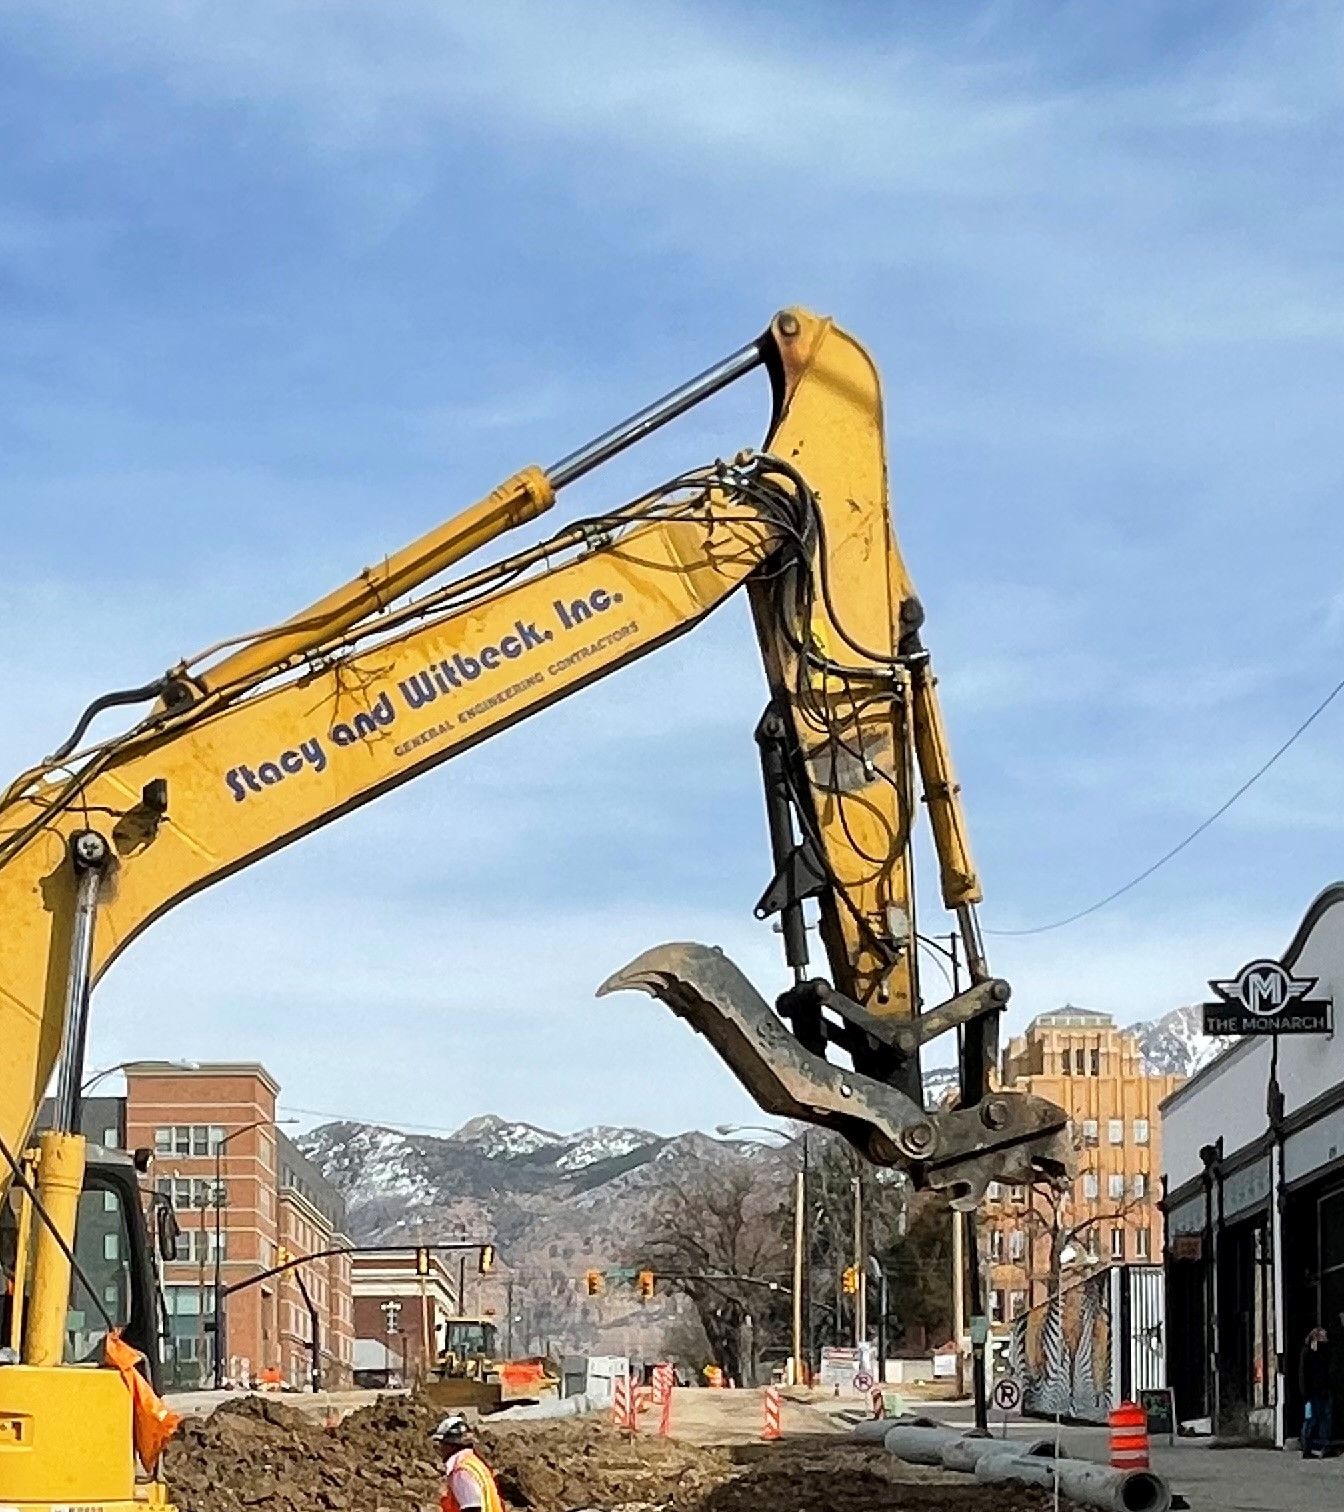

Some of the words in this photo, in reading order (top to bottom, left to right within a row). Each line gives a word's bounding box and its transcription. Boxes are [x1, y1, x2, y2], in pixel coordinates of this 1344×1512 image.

[226, 737, 326, 802] Stacy
[332, 690, 395, 746] and
[398, 620, 554, 709] Witbeck,
[553, 588, 624, 630] Inc.
[393, 720, 455, 756] GENERAL
[457, 672, 545, 723] ENGINEERING
[547, 621, 639, 675] CONTRACTORS
[1207, 1016, 1238, 1032] THE
[1242, 1016, 1324, 1031] MONARCH
